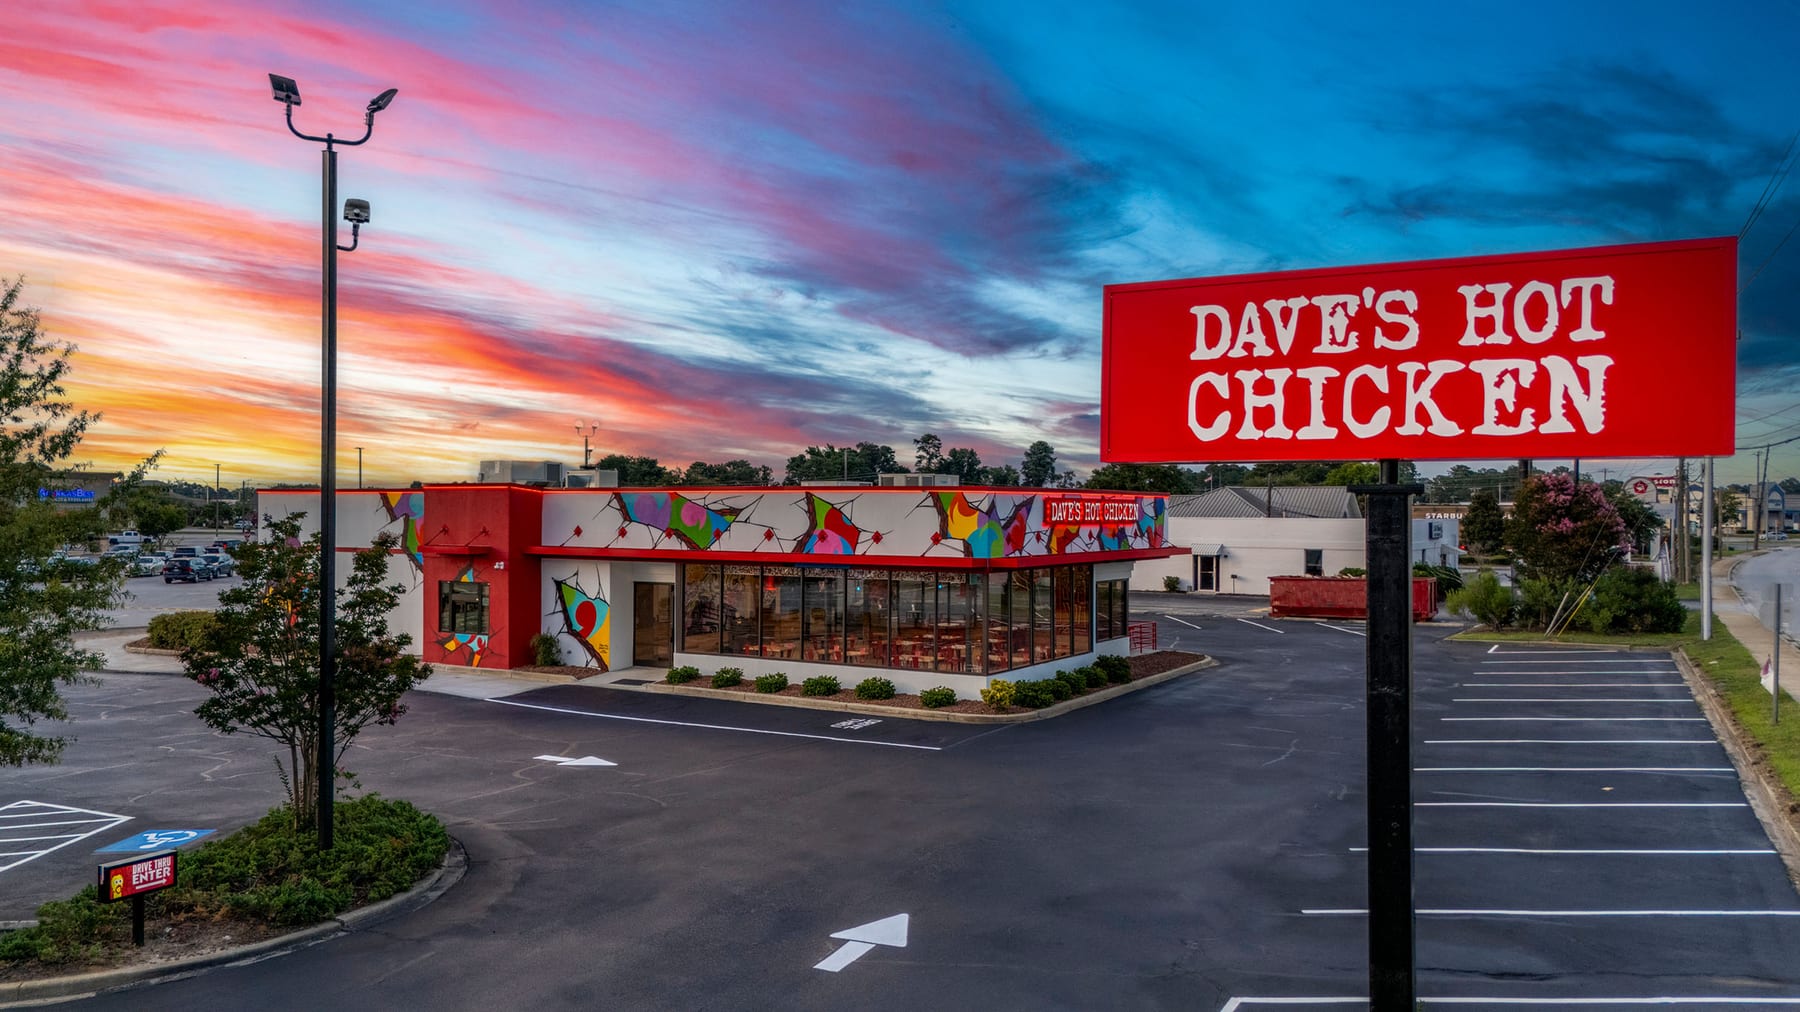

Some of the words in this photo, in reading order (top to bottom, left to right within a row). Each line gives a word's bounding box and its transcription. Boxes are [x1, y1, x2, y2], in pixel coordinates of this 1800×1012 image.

[1190, 287, 1419, 361] DAVE'S
[1458, 275, 1615, 346] HOT
[1187, 354, 1615, 442] CHICKEN
[1051, 501, 1080, 521] DAVE'S
[1084, 502, 1101, 521] HOT
[1103, 503, 1139, 521] CHICKEN
[132, 861, 153, 874] DRIVE
[154, 856, 171, 869] THRU
[132, 867, 170, 885] ENTER
